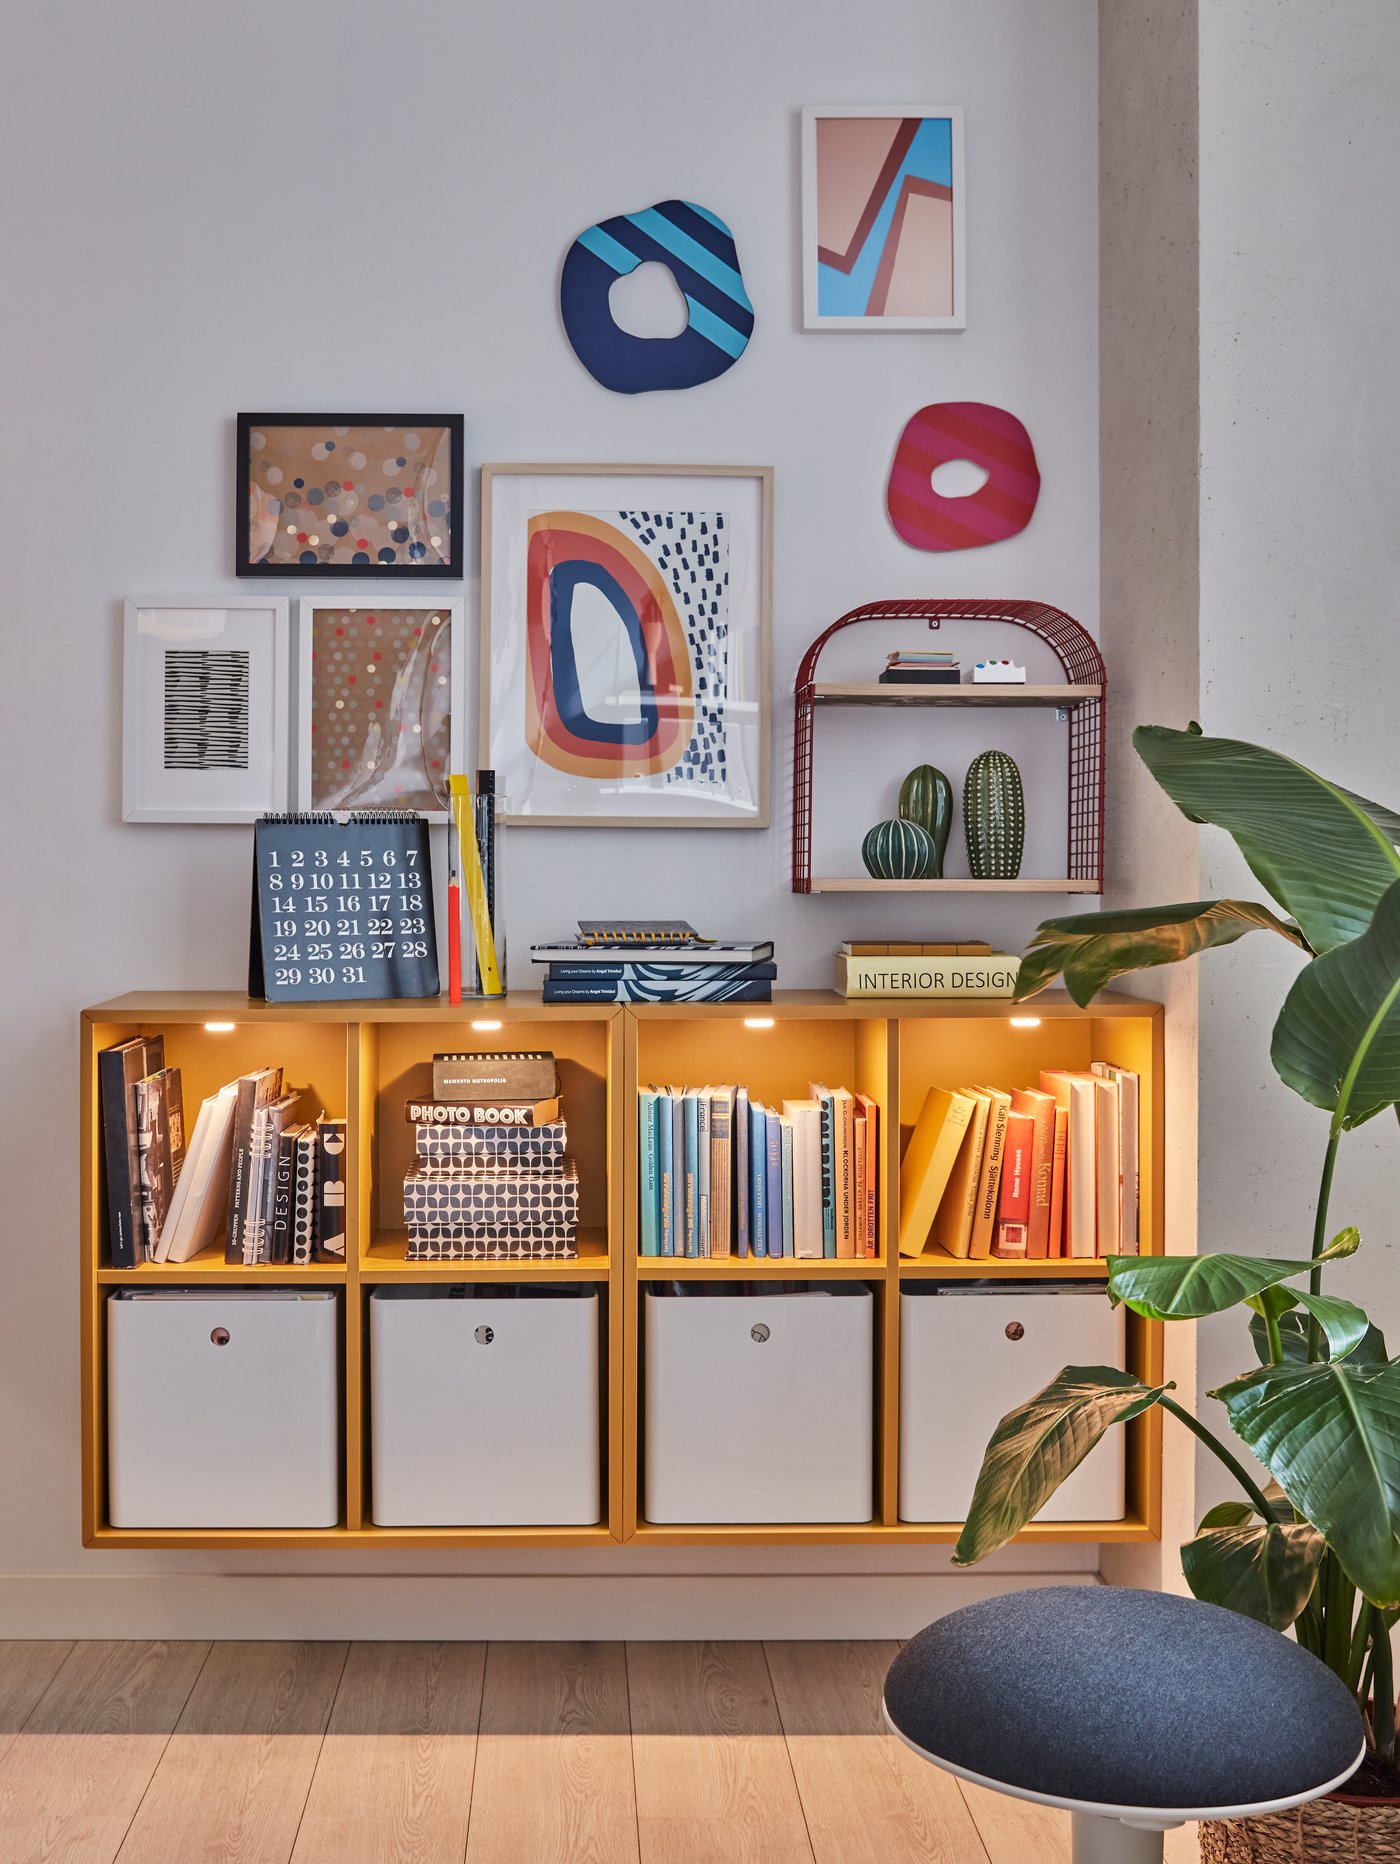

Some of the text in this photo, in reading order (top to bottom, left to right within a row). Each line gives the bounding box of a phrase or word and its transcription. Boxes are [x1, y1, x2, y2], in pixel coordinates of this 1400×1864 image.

[269, 850, 418, 868] 1 2 3 4 5 6 7
[269, 873, 421, 890] 8 9 10 11 12 13
[272, 895, 423, 913] 14 15 16 17 18
[274, 918, 425, 937] 19 20 21 22 23
[274, 942, 428, 961] 24 25 26 27 28
[275, 967, 367, 985] 29 30 31
[859, 972, 1019, 989] INTERIOR DESIGN
[410, 1106, 528, 1124] PHOTO BOOK
[1013, 1149, 1022, 1176] Houses
[274, 1156, 290, 1230] DESIGN
[983, 1166, 998, 1219] Sjättekolonn
[1036, 1162, 1050, 1206] Konrad
